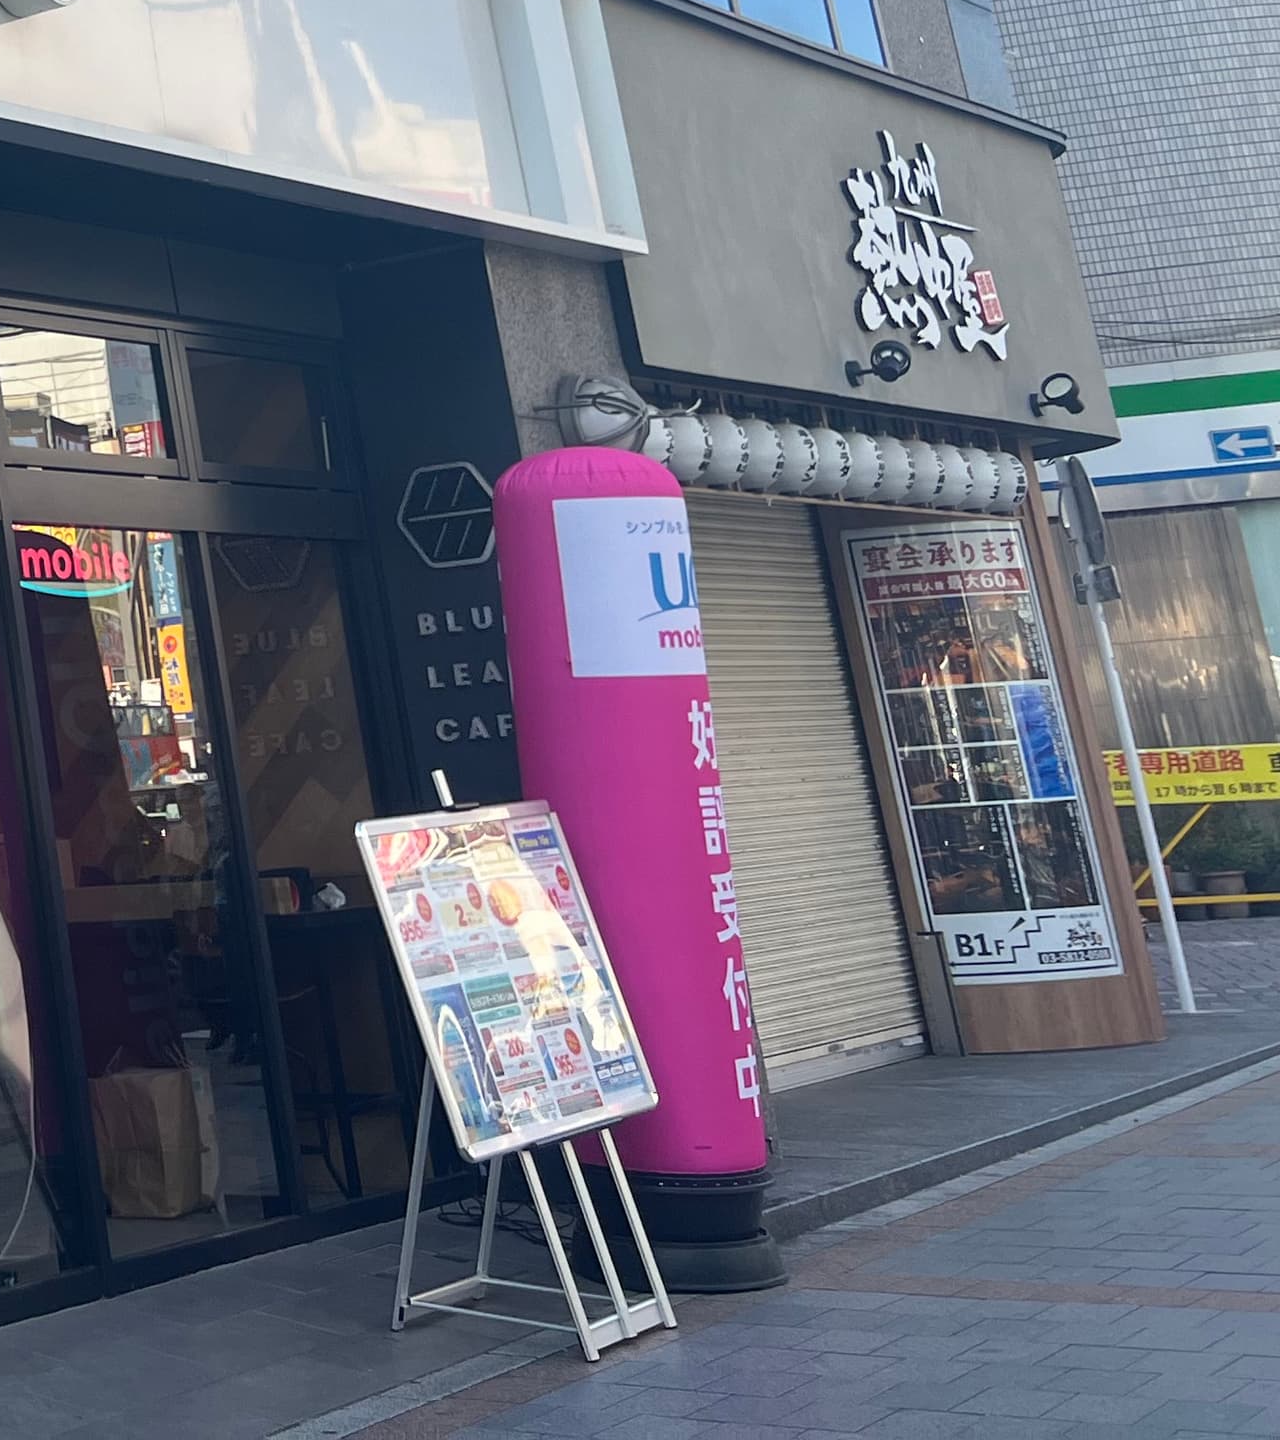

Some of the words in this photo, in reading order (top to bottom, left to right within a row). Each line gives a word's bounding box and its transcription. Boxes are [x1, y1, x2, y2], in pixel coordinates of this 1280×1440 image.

[21, 542, 131, 582] mobile
[862, 537, 1017, 573] 宴会承ります
[416, 605, 493, 636] BLU
[954, 933, 1006, 958] B1F
